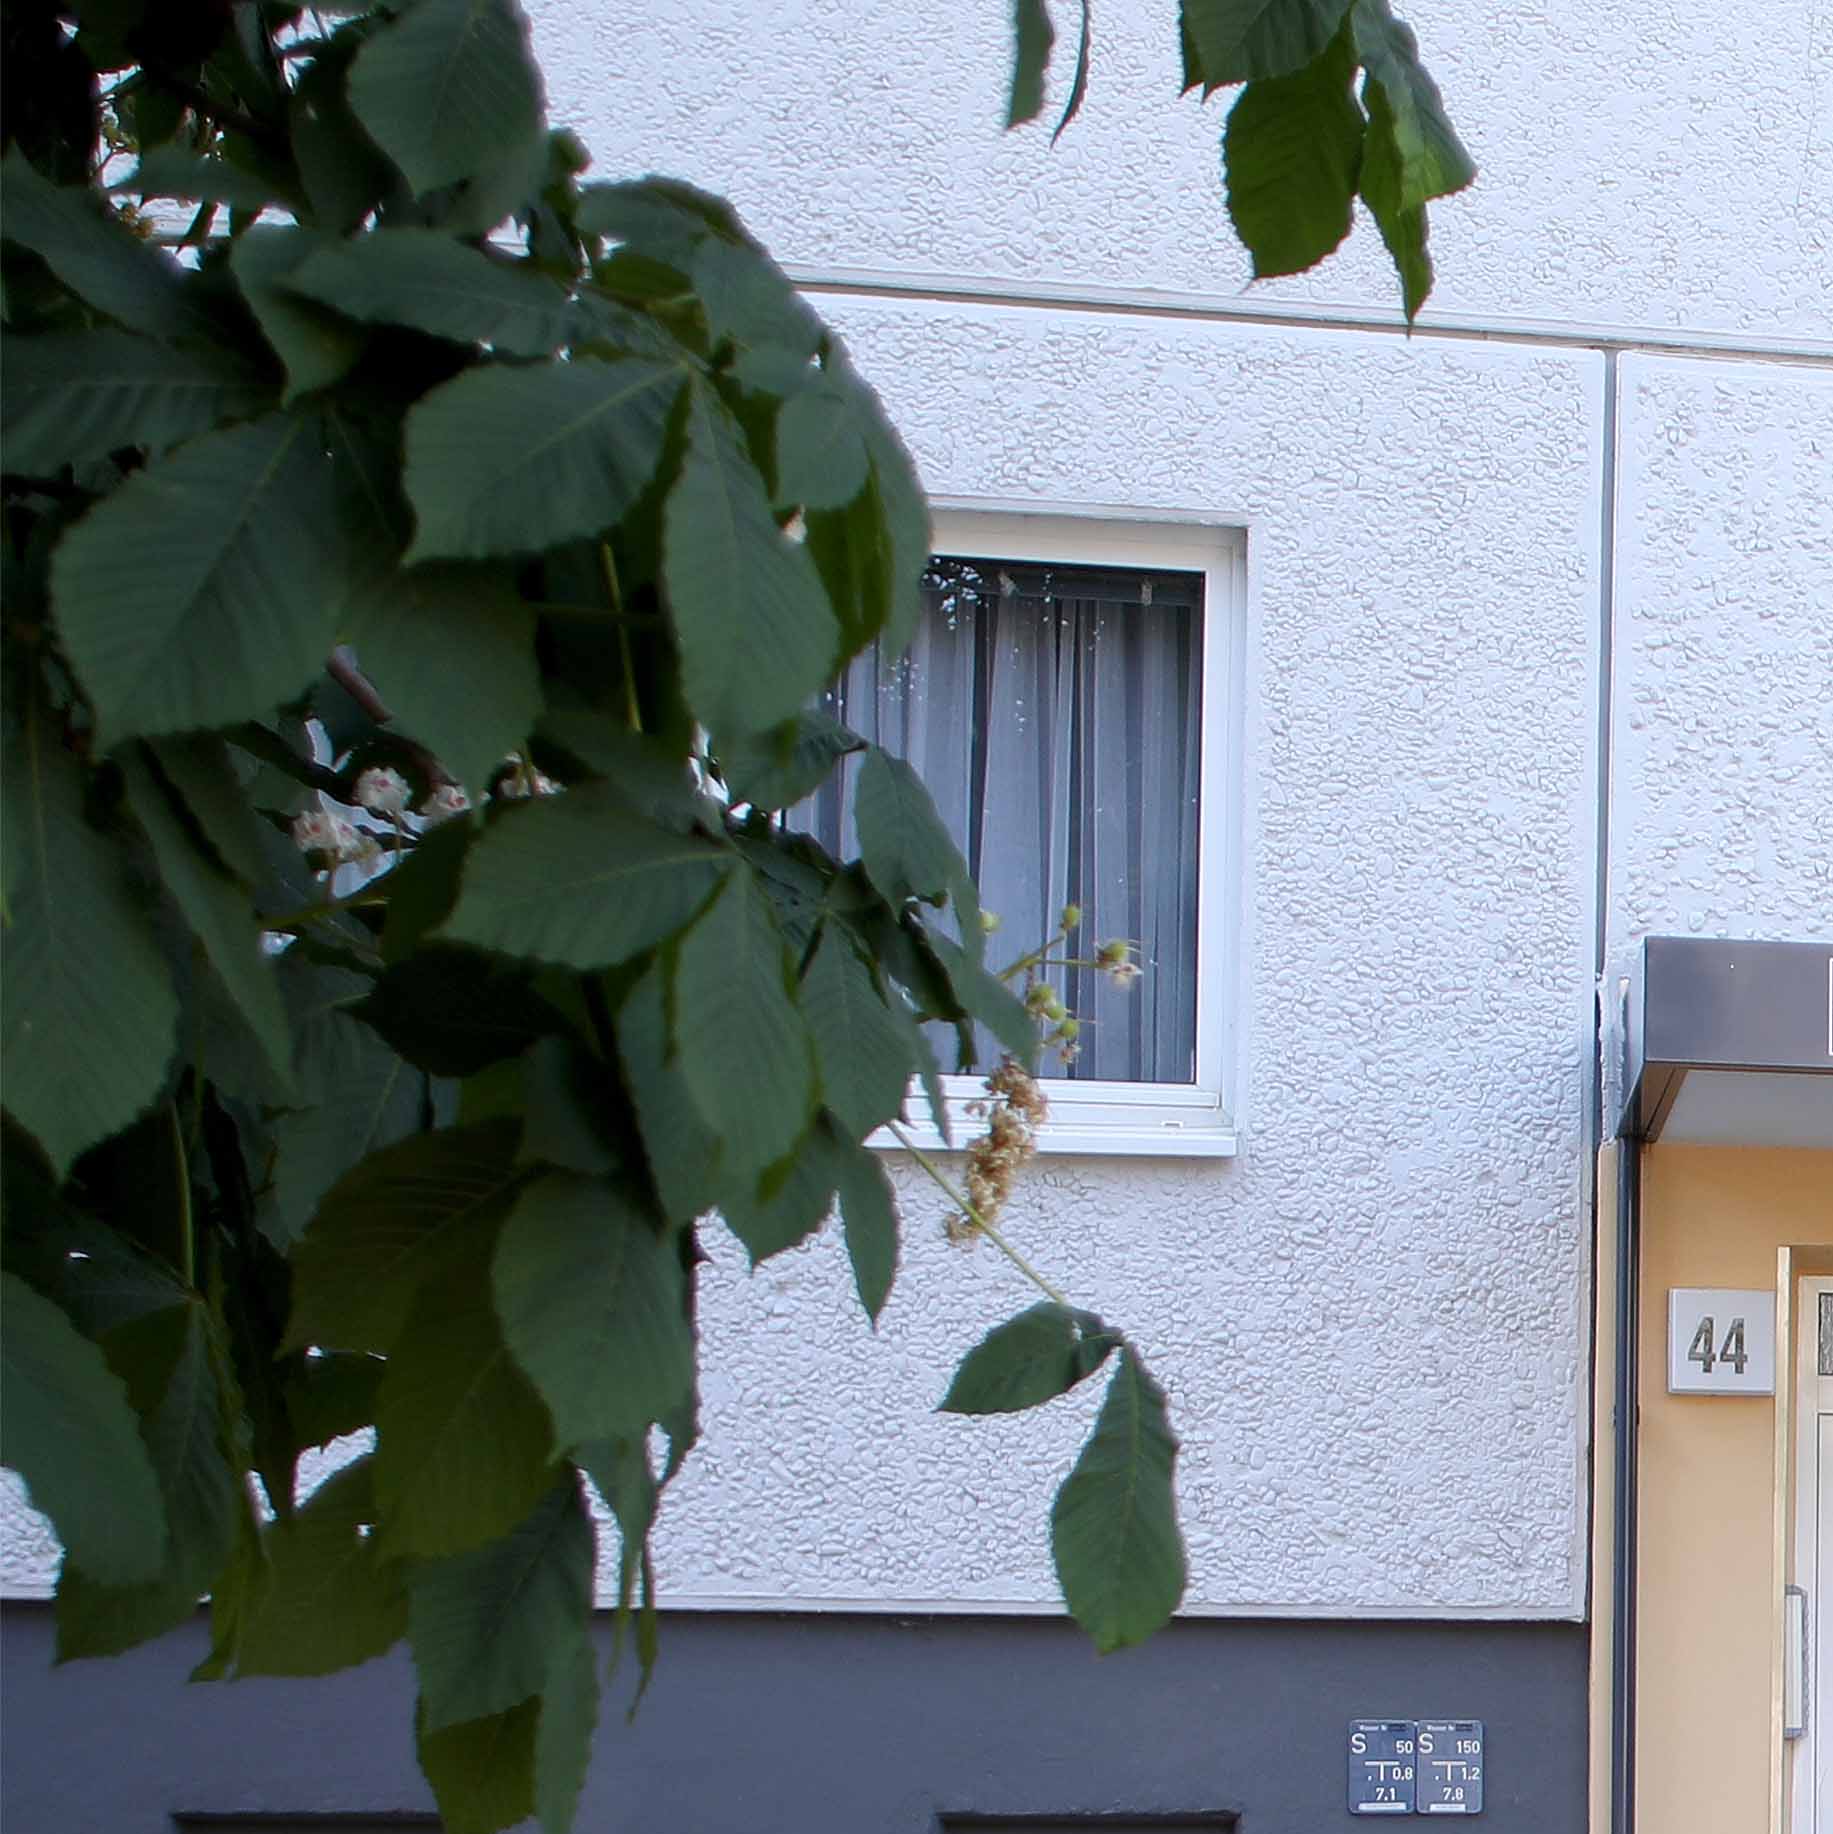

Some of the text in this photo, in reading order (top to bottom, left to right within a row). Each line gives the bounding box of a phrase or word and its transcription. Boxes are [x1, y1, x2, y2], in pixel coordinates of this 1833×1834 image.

[1687, 1316, 1748, 1374] 44
[1351, 1732, 1414, 1754] S 50
[1418, 1732, 1480, 1754] S 150
